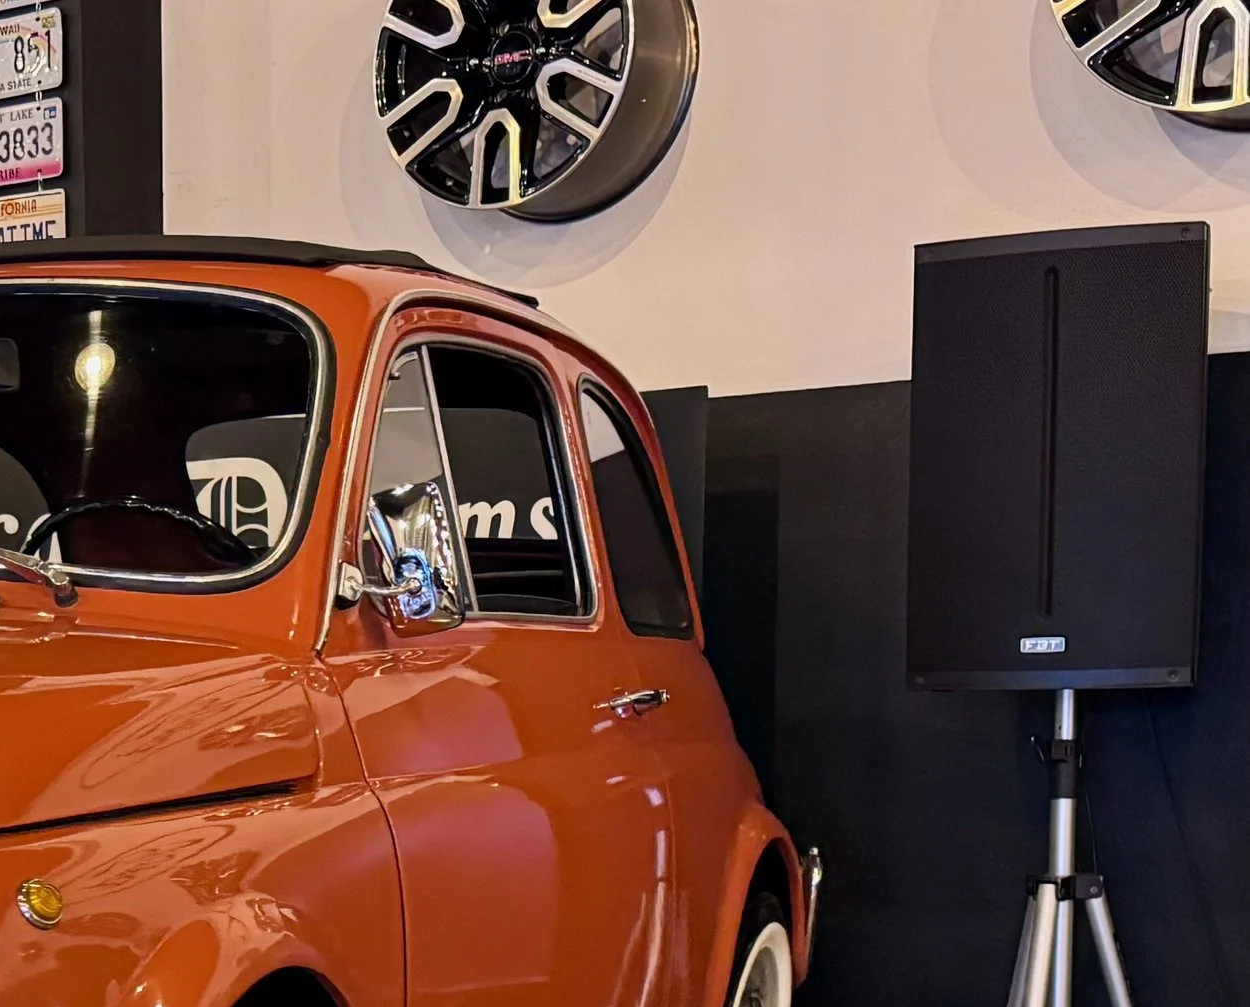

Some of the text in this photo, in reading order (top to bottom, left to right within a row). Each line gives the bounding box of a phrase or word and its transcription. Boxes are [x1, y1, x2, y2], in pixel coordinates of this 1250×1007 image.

[14, 29, 51, 74] 851
[7, 78, 32, 91] STATE
[10, 108, 34, 121] LAKE
